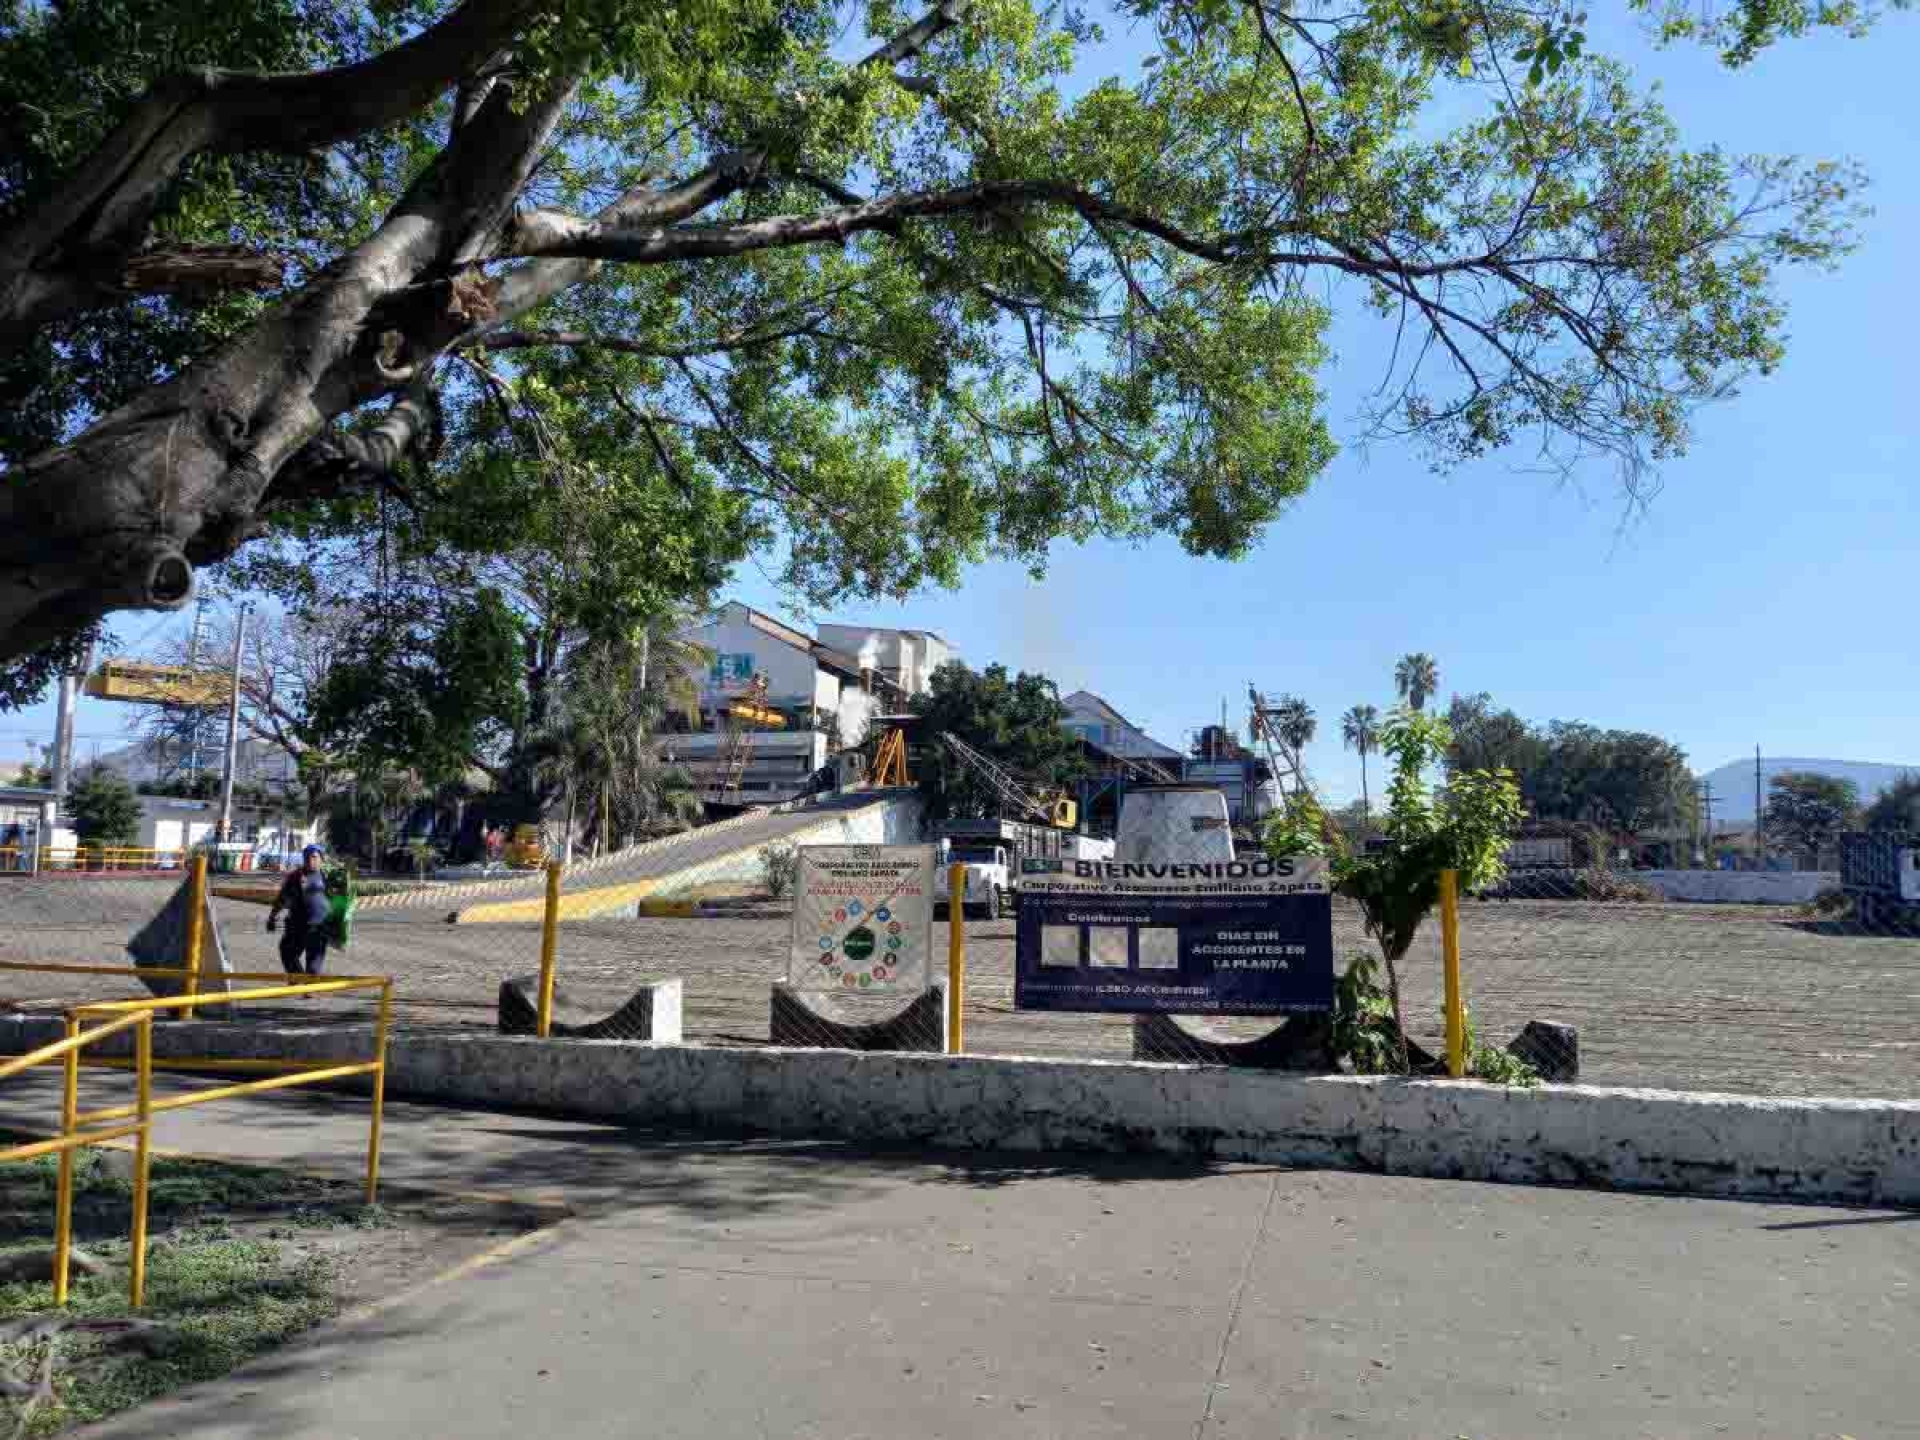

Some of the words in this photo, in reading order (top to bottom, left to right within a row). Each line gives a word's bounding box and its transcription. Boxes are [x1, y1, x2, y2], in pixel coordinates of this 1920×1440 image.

[1075, 859, 1295, 878] BIENVENIDOS
[1195, 881, 1263, 893] Emiliano
[1267, 881, 1323, 893] Zapata
[1217, 931, 1252, 940] DIAS
[1191, 945, 1283, 955] ACCIDENTES
[1213, 960, 1230, 969] LA
[1232, 960, 1289, 969] PLANTA
